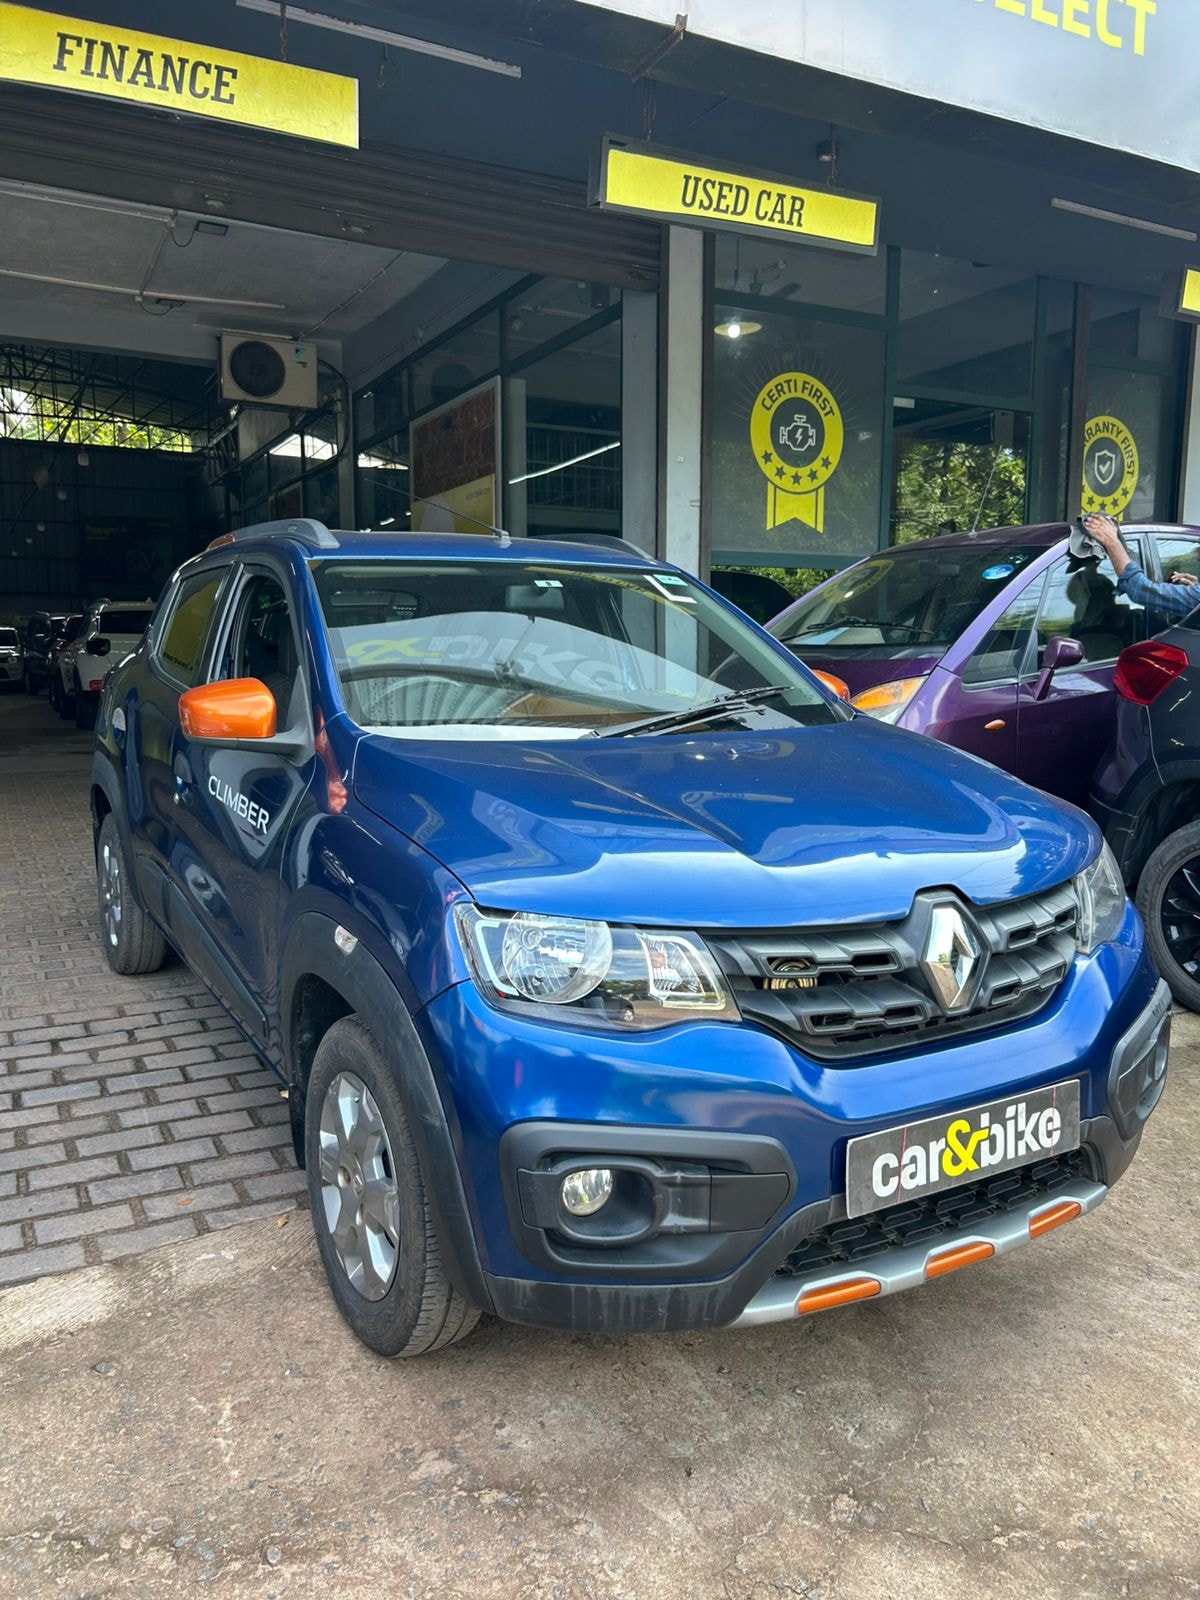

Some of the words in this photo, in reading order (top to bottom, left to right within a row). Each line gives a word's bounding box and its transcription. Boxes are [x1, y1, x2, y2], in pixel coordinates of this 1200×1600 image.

[973, 0, 1157, 56] LECT
[53, 31, 238, 104] FINANCE
[681, 174, 750, 216] USED
[755, 189, 805, 227] CAR
[761, 378, 798, 412] CERTI
[801, 380, 835, 417] FIRST
[1084, 421, 1122, 444] RANTY
[1121, 437, 1135, 477] FIRST
[207, 775, 270, 834] CLIMBER
[872, 1102, 1062, 1197] car&bike
